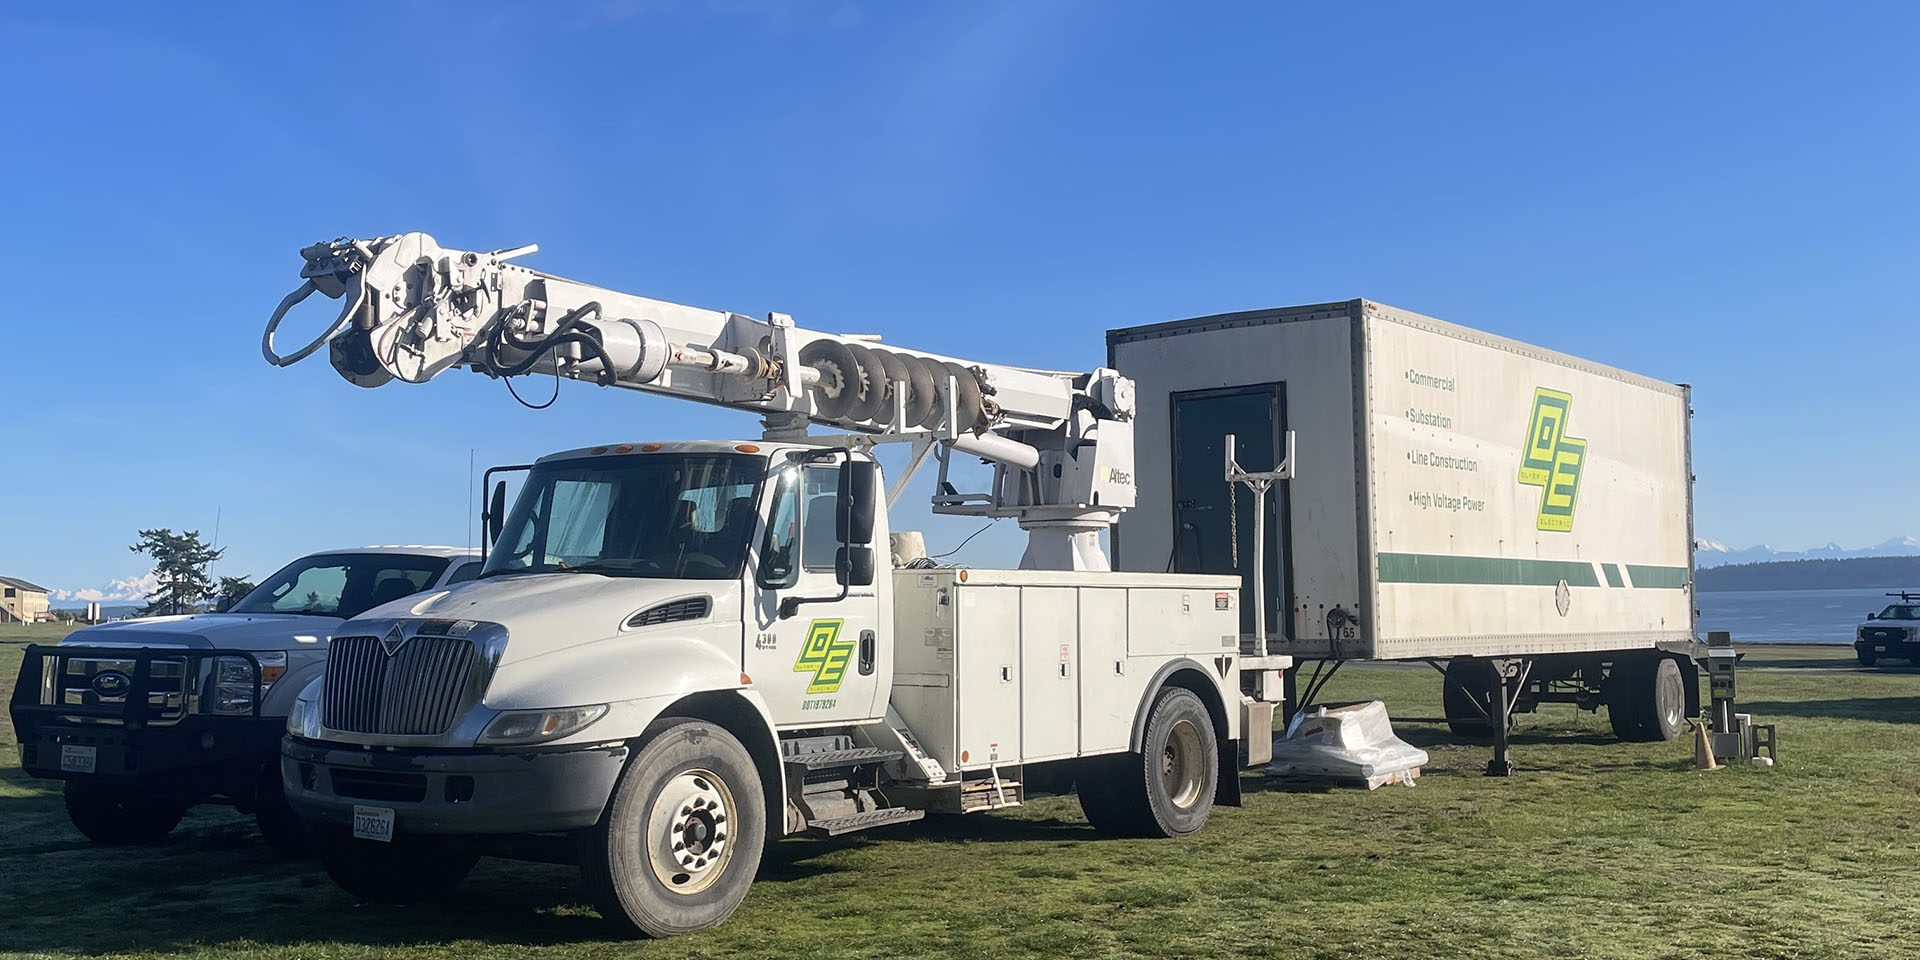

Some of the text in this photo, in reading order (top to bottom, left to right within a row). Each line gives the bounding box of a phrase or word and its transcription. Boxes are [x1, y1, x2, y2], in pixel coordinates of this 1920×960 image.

[1409, 369, 1455, 392] Commercial
[1410, 408, 1452, 429] Substation
[1411, 449, 1478, 473] Line Construction
[1109, 467, 1131, 485] Altec
[1413, 491, 1485, 512] High Voltage Power
[1540, 518, 1570, 528] ELECTRIC
[1343, 627, 1355, 639] 65
